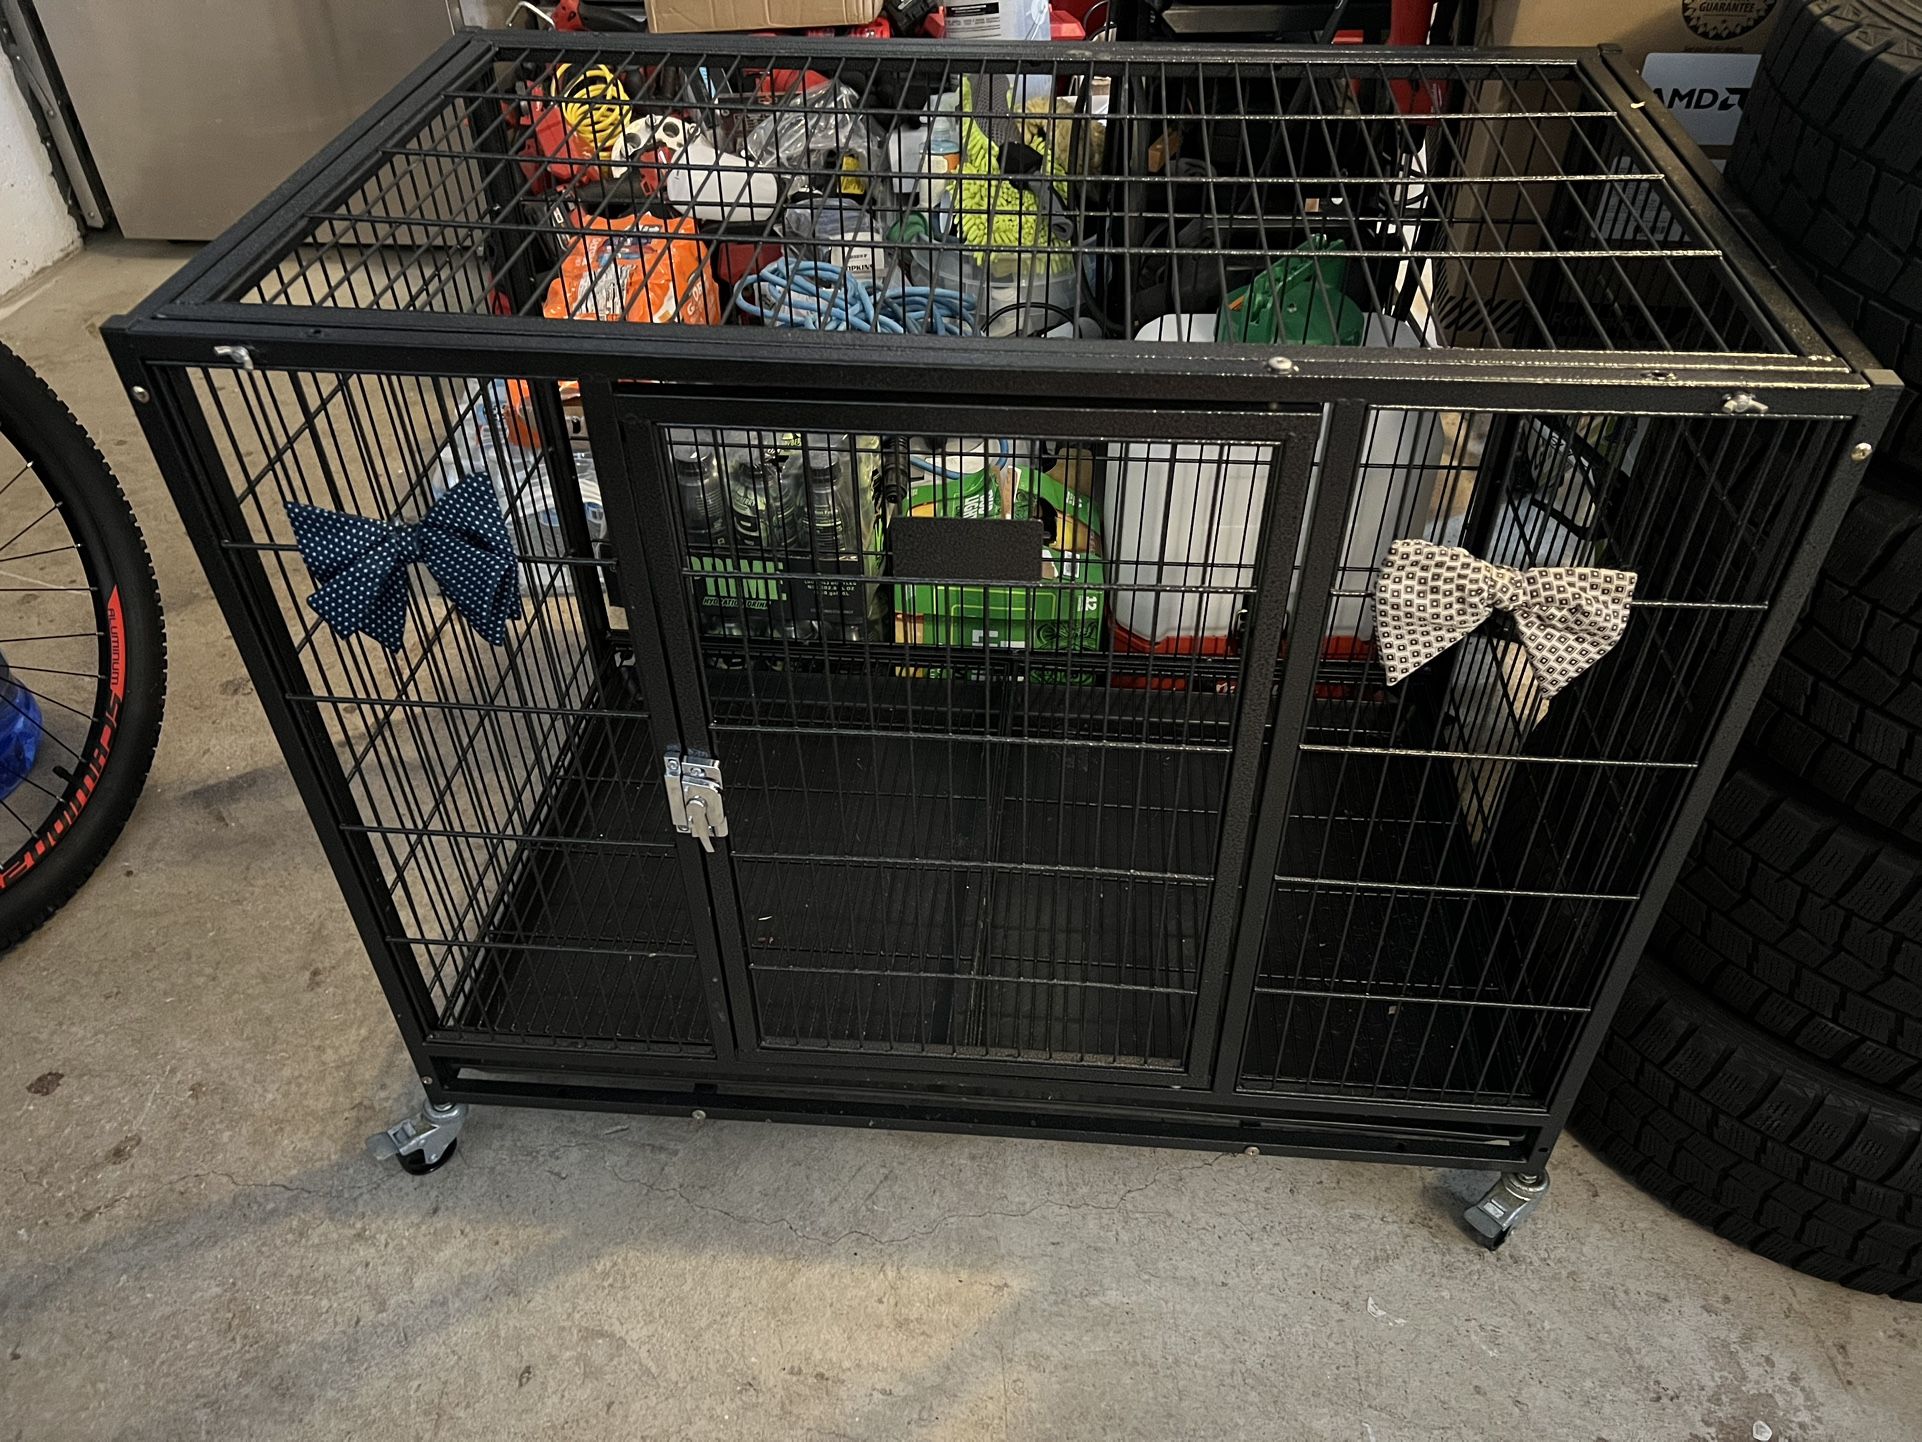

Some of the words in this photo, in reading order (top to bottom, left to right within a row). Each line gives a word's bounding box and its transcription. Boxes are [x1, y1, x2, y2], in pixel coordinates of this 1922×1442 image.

[1699, 1, 1754, 12] GUARANTEE
[1653, 87, 1719, 109] AMD
[1085, 595, 1098, 611] 12
[108, 608, 120, 685] ALUMINUM
